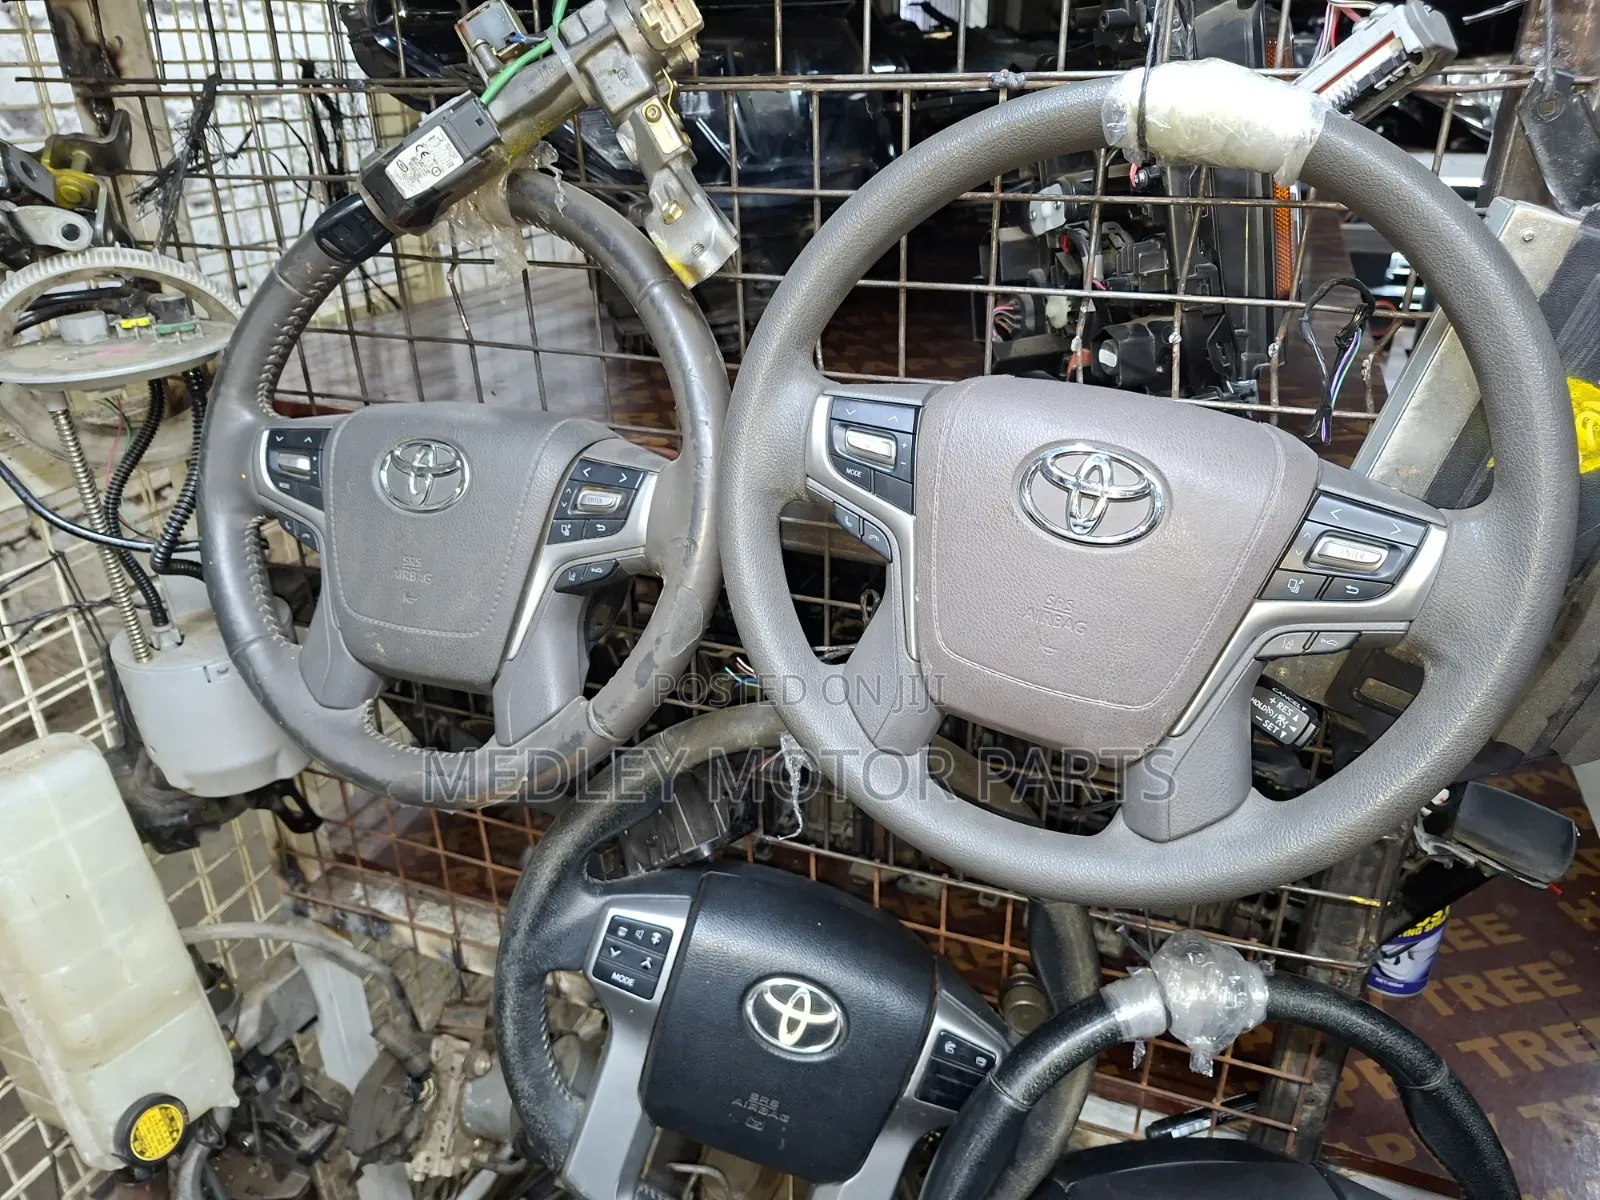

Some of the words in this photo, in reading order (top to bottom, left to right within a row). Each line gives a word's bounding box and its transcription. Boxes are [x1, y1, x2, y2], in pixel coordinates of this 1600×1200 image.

[845, 467, 862, 478] MODE
[403, 555, 422, 567] SRS
[392, 570, 433, 584] AIRBAG
[1045, 594, 1075, 611] SRS
[1023, 607, 1088, 635] AIRBAG
[1251, 697, 1268, 712] HOLD
[1272, 688, 1301, 709] CANCEL
[1276, 701, 1293, 716] RES
[1263, 720, 1280, 734] SET
[611, 972, 636, 987] MODE
[1420, 961, 1582, 1016] TREE
[748, 1092, 780, 1108] SRS
[731, 1098, 791, 1123] AIRBAG
